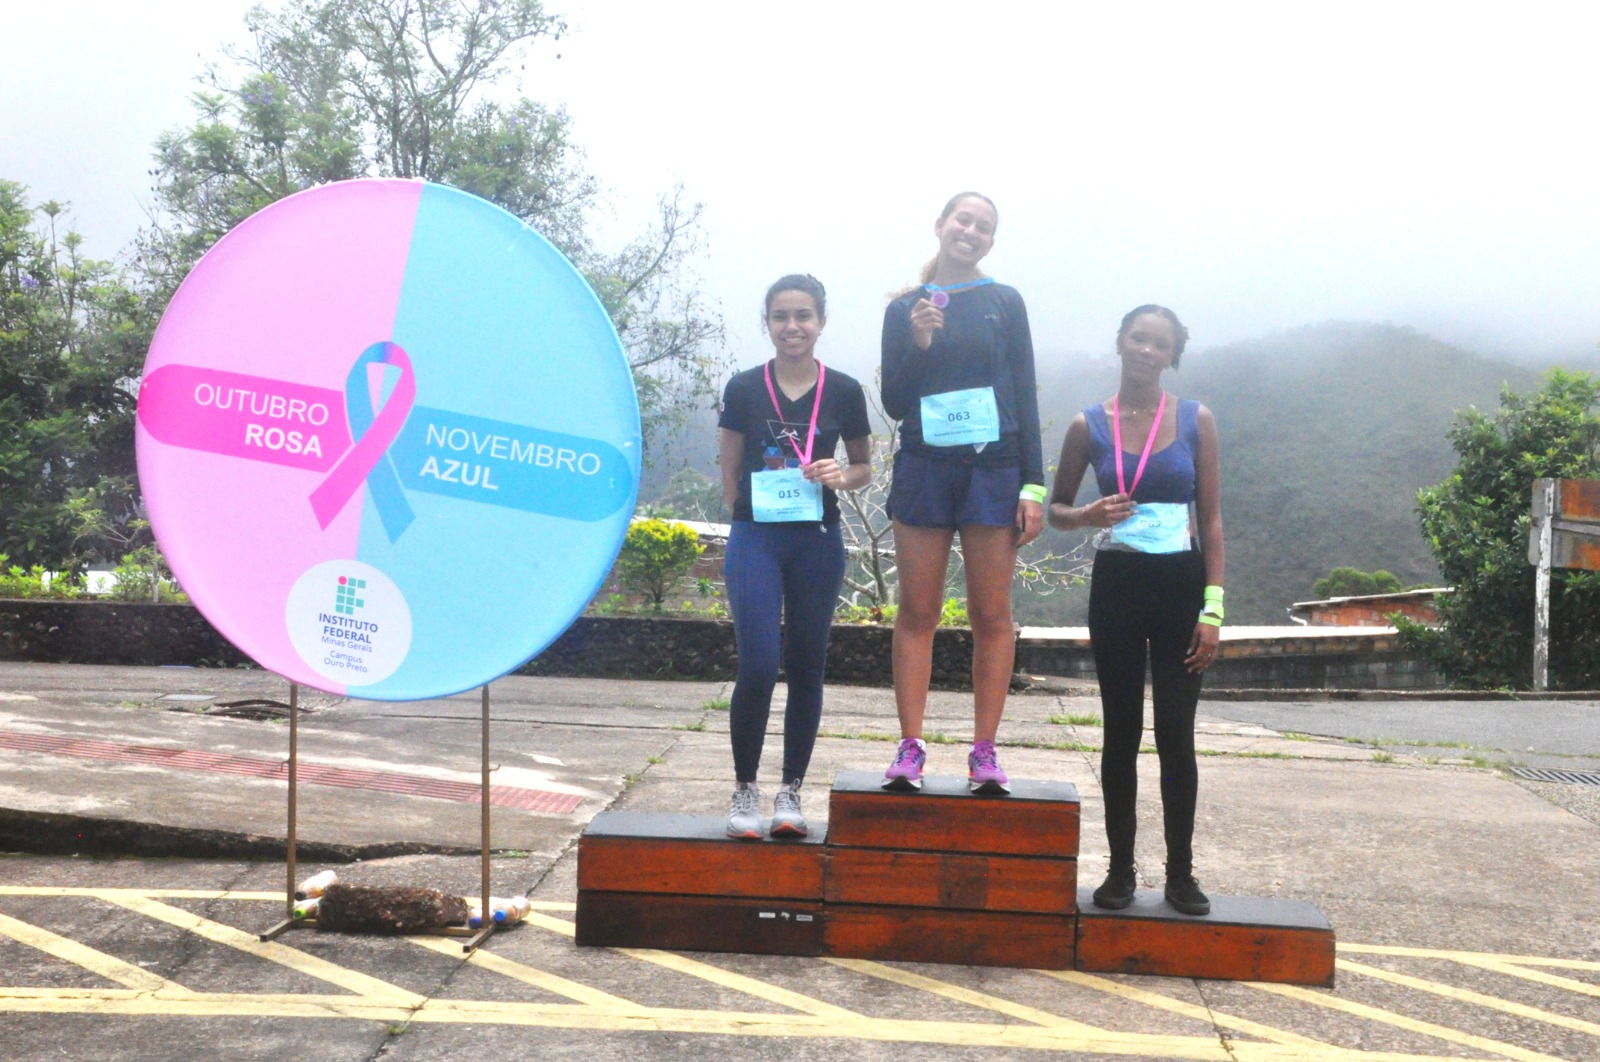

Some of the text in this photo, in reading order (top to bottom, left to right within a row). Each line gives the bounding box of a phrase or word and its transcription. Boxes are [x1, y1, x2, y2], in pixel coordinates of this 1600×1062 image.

[193, 381, 330, 427] OUTUBRO
[947, 411, 970, 422] 063
[244, 422, 324, 458] ROSA
[425, 422, 602, 476] NOVEMBRO
[418, 456, 500, 491] AZUL
[778, 489, 800, 499] 015
[319, 613, 378, 633] INSTITUTO
[323, 626, 372, 644] FEDERAL
[321, 636, 373, 653] Minas Gerais
[323, 657, 368, 673] Ouro Preto
[329, 650, 363, 664] Campus
